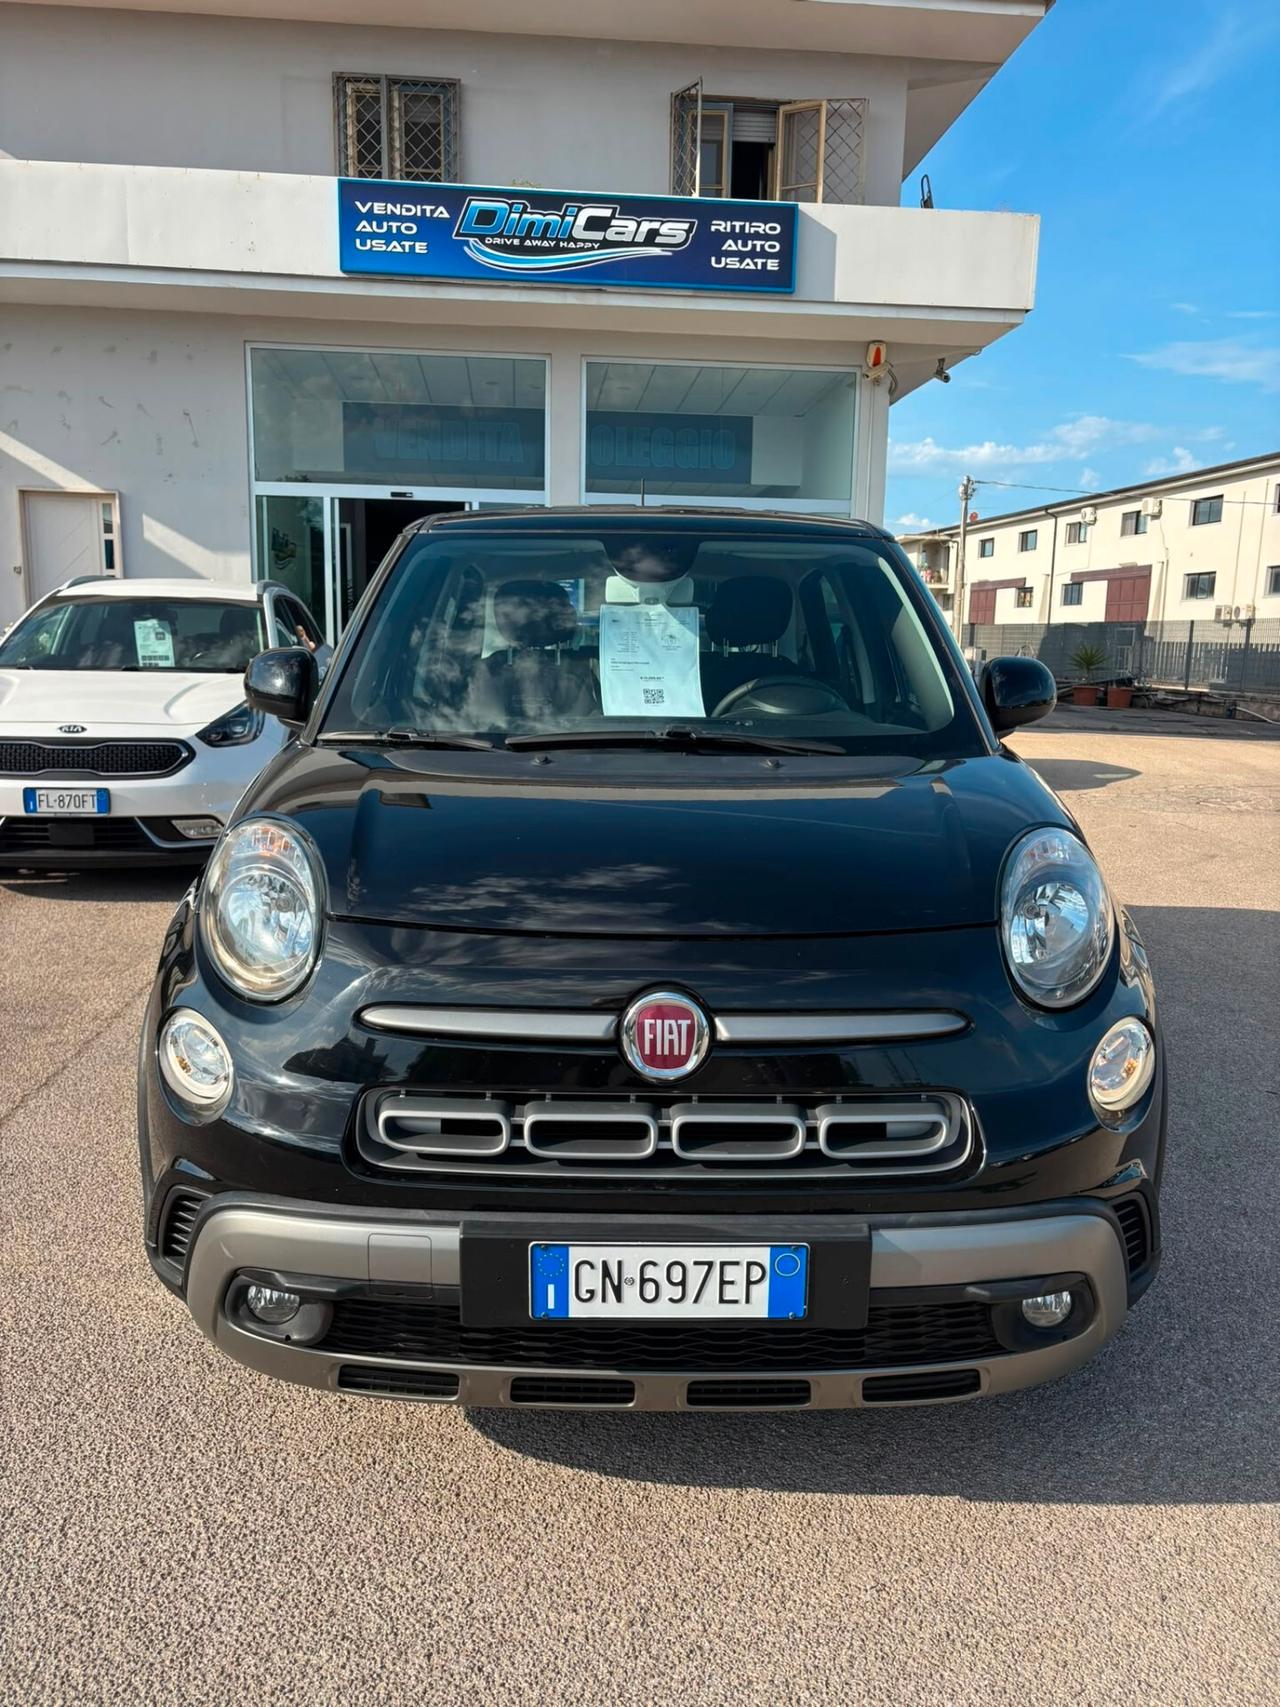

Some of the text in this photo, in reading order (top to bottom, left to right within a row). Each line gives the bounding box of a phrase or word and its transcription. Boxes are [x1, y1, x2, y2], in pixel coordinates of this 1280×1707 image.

[355, 201, 450, 218] VENDITA
[355, 220, 417, 234] AUTO
[458, 199, 692, 244] DimiCars
[710, 220, 781, 234] RITIRO
[355, 239, 428, 253] USATE
[485, 237, 601, 249] DRIVE AWAY HAPPY
[721, 239, 780, 252] AUTO
[710, 257, 780, 270] USATE
[590, 424, 736, 471] OLEGGIO
[644, 1019, 692, 1056] FIAT
